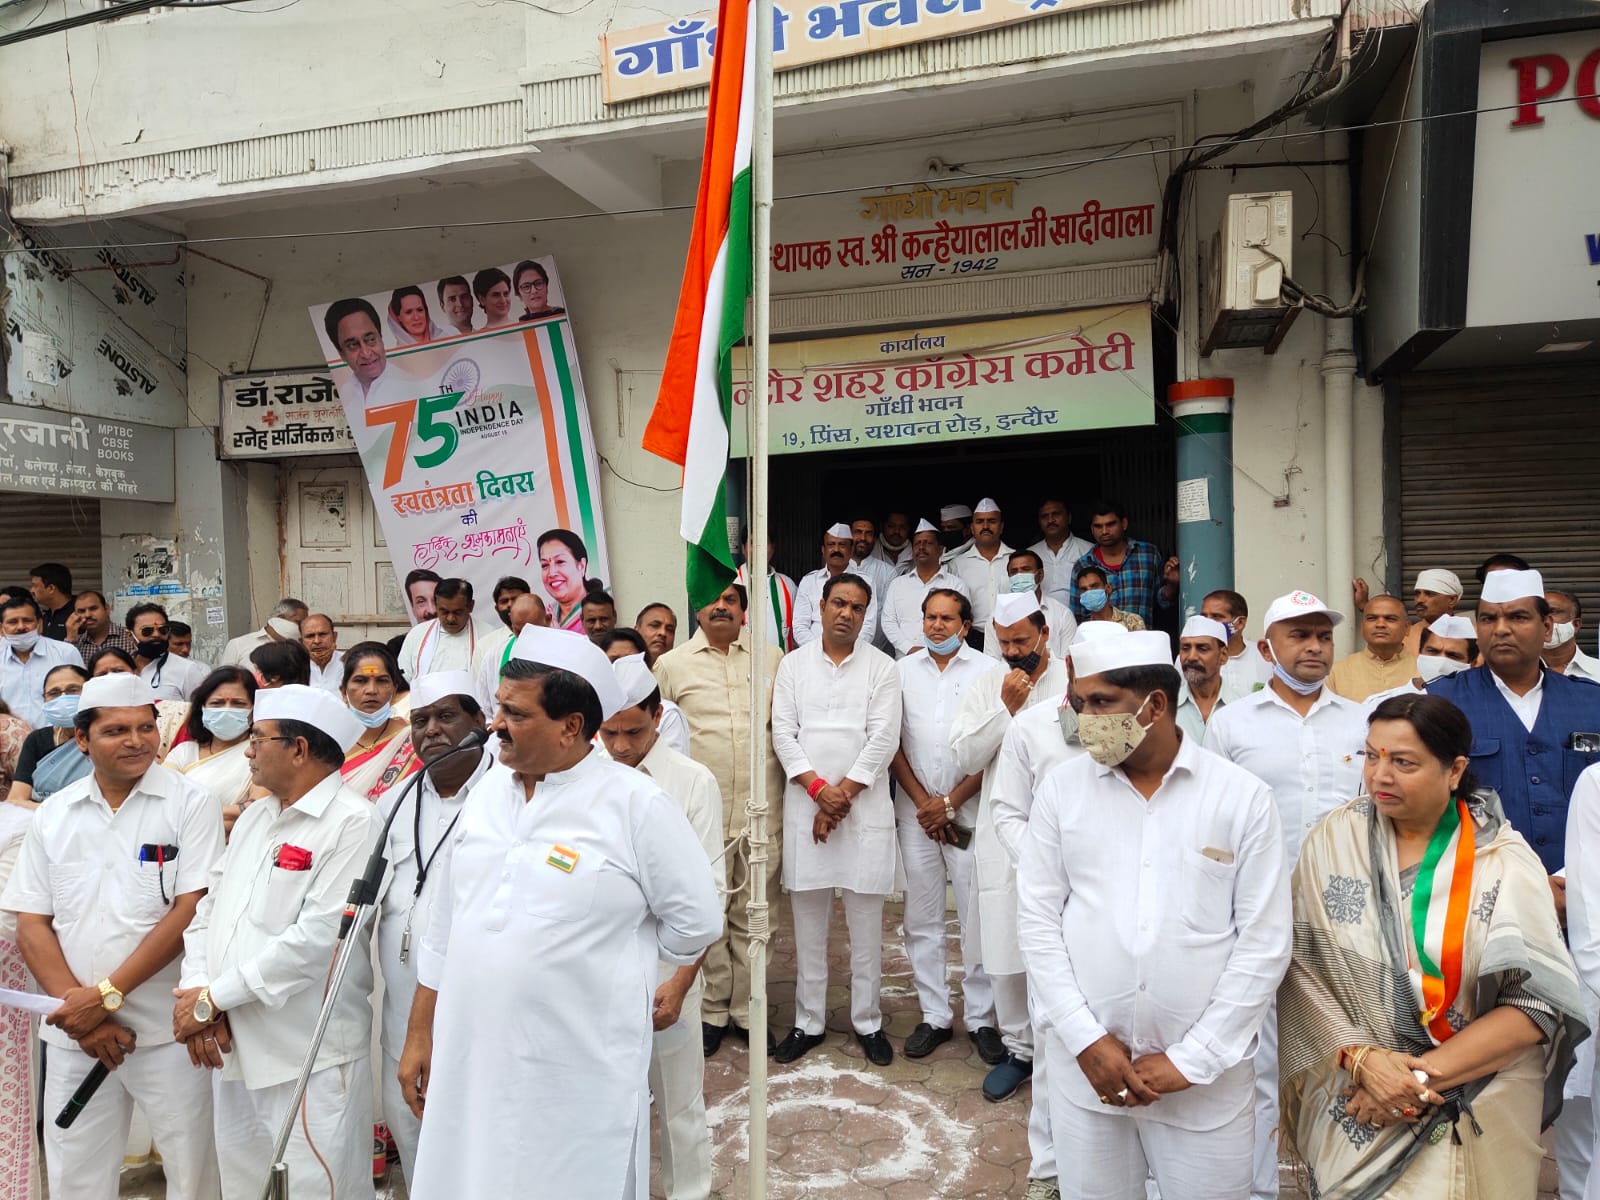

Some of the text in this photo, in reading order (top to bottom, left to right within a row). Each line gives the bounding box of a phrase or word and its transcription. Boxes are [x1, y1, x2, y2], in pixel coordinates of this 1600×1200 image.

[871, 224, 898, 264] श्री
[901, 263, 935, 279] सन
[951, 257, 999, 275] 1942
[880, 334, 946, 353] कार्यालय
[97, 338, 157, 395] ALSTONE
[813, 369, 886, 403] शहर
[1023, 332, 1136, 380] कमेटी
[439, 384, 453, 395] TH
[455, 400, 524, 428] INDIA
[865, 395, 964, 418] गाँधी भवन
[98, 423, 134, 438] MPTBC
[460, 418, 525, 436] INDEPENDENCE DAY
[865, 420, 941, 440] यशवन्त
[996, 406, 1059, 431] इन्दौर
[102, 436, 130, 450] CBSE
[233, 425, 269, 451] स्नेह
[271, 423, 335, 447] सर्जिकल
[365, 391, 466, 491] 75
[97, 449, 134, 462] BOOKS
[391, 470, 535, 513] स्वतंत्रता दिवस
[460, 508, 478, 527] की
